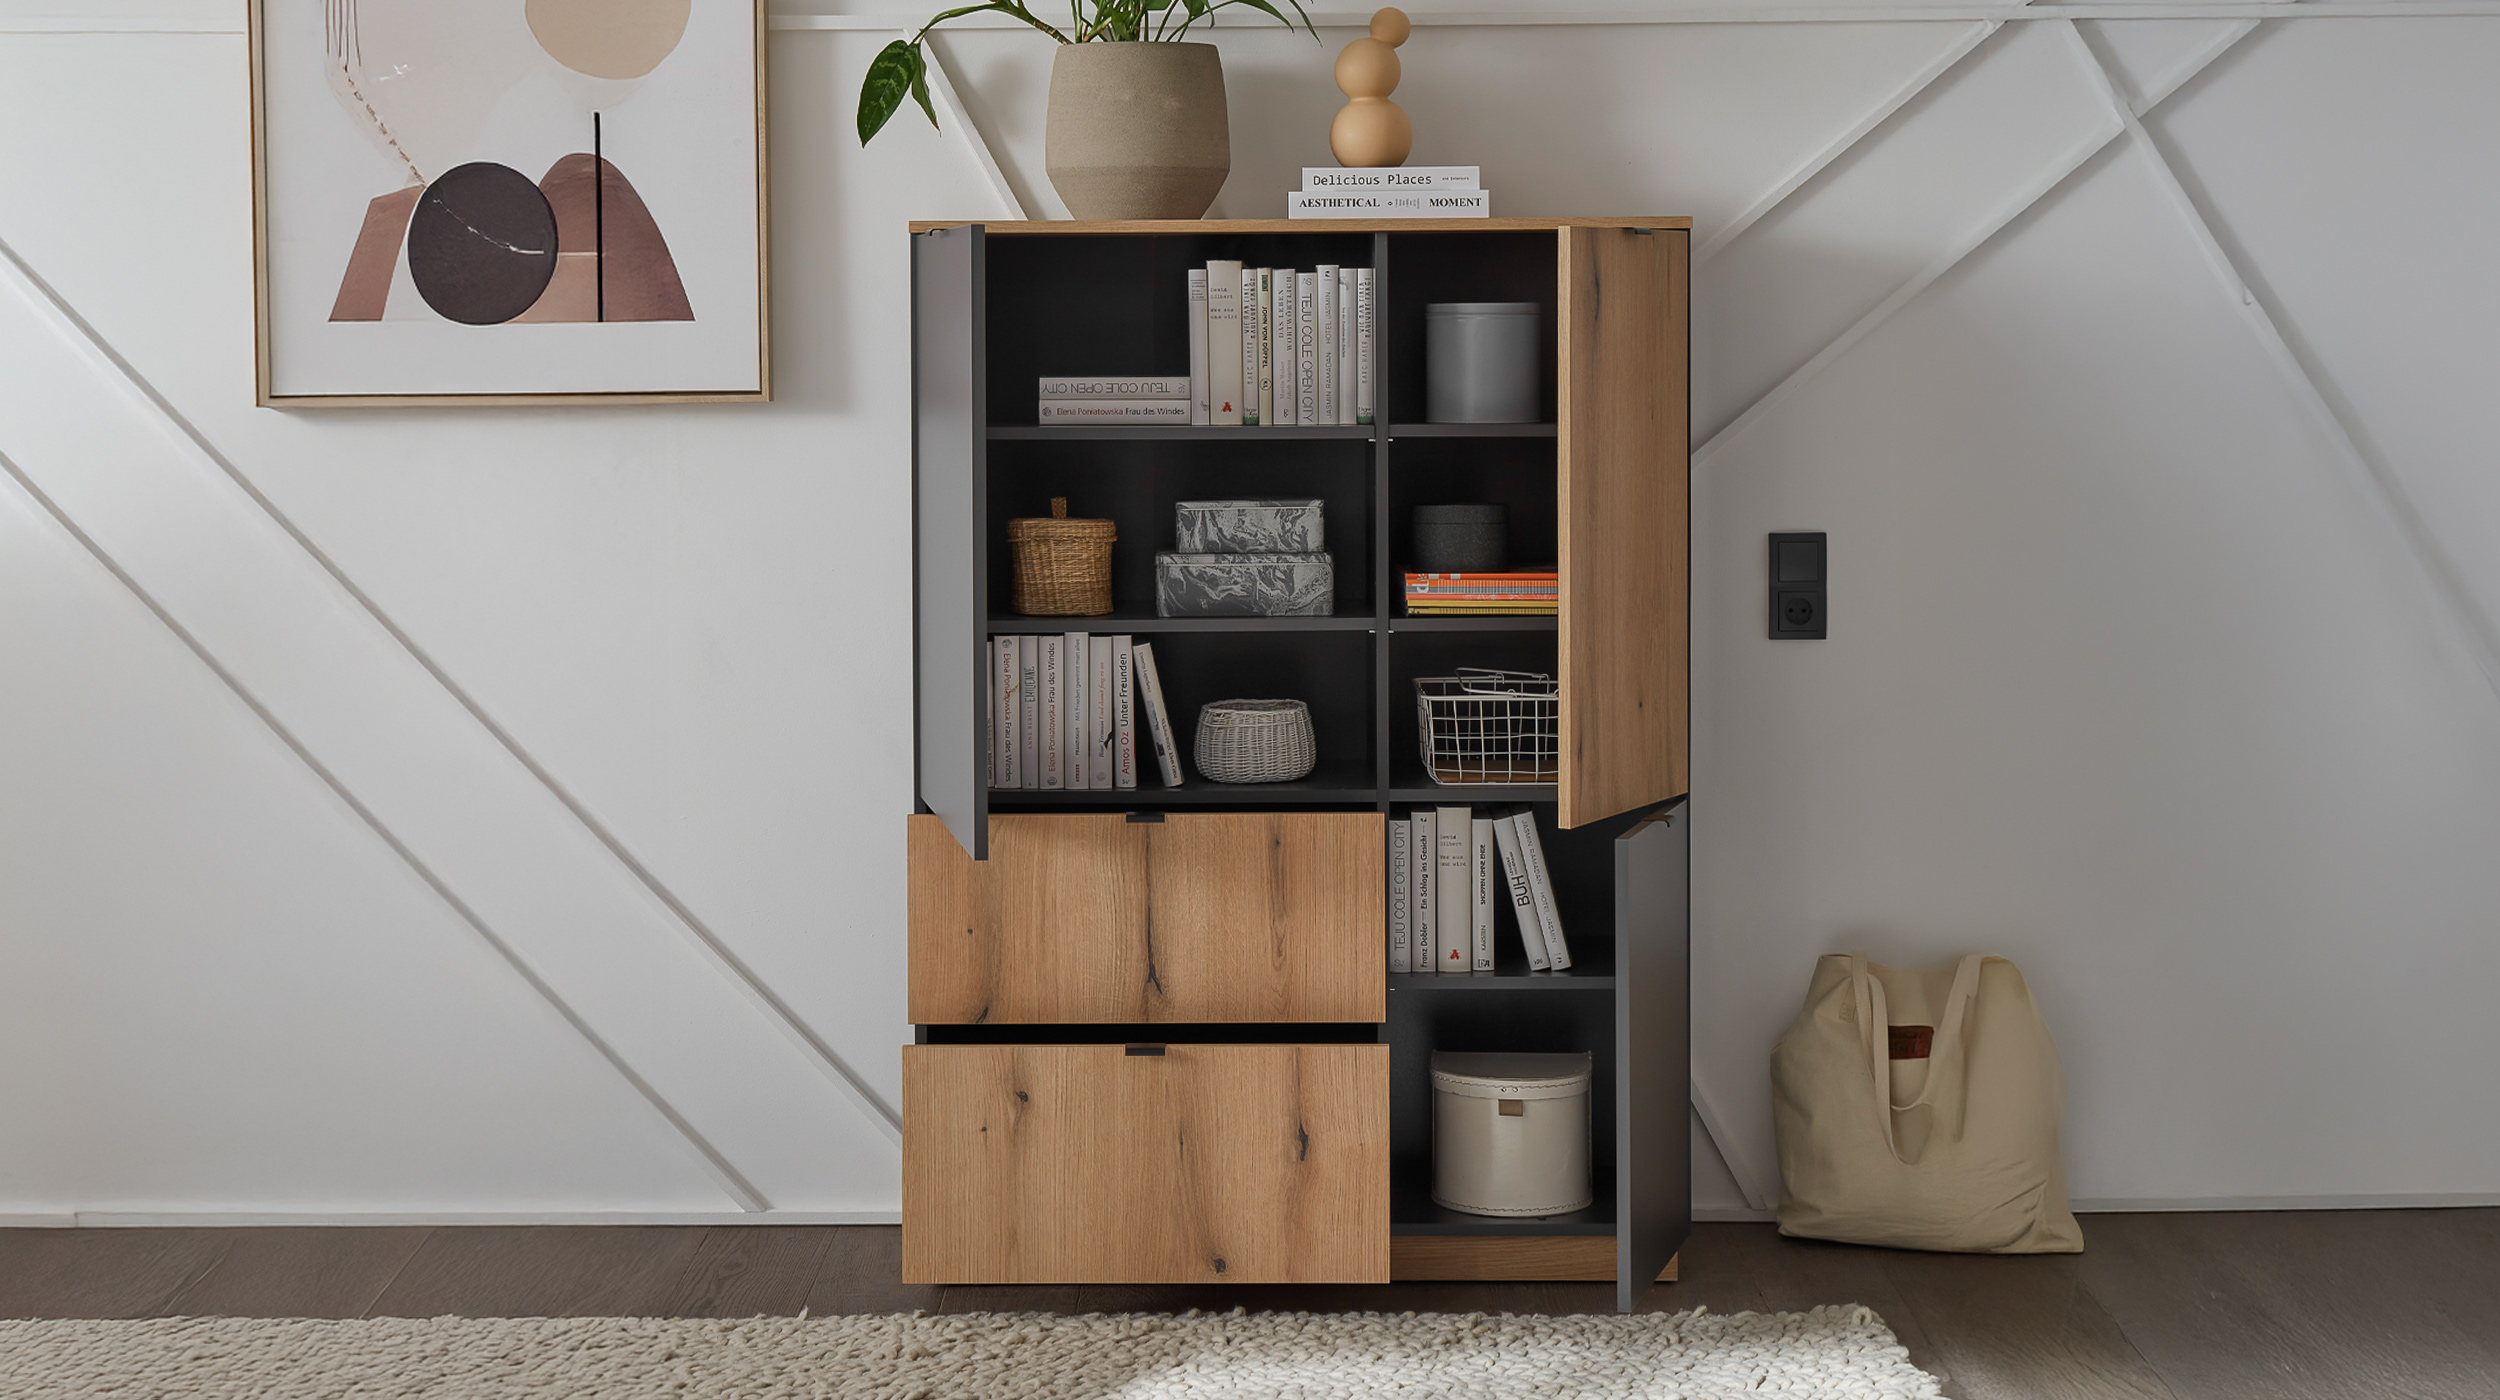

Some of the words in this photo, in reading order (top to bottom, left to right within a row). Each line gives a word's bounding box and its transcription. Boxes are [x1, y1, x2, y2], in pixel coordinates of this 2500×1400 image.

[1313, 174, 1380, 186] Delicious
[1388, 174, 1432, 185] Places
[1299, 198, 1380, 208] AESTHETICAL
[1429, 198, 1482, 208] MOMENT
[1301, 293, 1312, 322] TEJU
[1302, 325, 1312, 357] COLE
[1042, 383, 1067, 394] CITY
[1071, 383, 1103, 394] OPEN
[1106, 383, 1139, 393] COLE
[1141, 383, 1170, 393] TEJU
[1302, 361, 1312, 393] OPEN
[1302, 397, 1313, 422] CITY
[1118, 654, 1128, 697] Freunden
[1120, 699, 1128, 727] Unter
[1120, 732, 1129, 745] Oz
[1120, 748, 1130, 774] Amos
[1394, 823, 1406, 848] CITY
[1522, 820, 1533, 847] JASMIN
[1530, 848, 1543, 885] RAMADAN
[1394, 851, 1406, 884] OPEN
[1420, 874, 1428, 897] Schlag
[1513, 874, 1530, 907] BUH
[1394, 887, 1406, 919] COLE
[1540, 892, 1550, 914] HOTEL
[1547, 917, 1557, 943] JASMIN
[1394, 922, 1406, 951] TEJU
